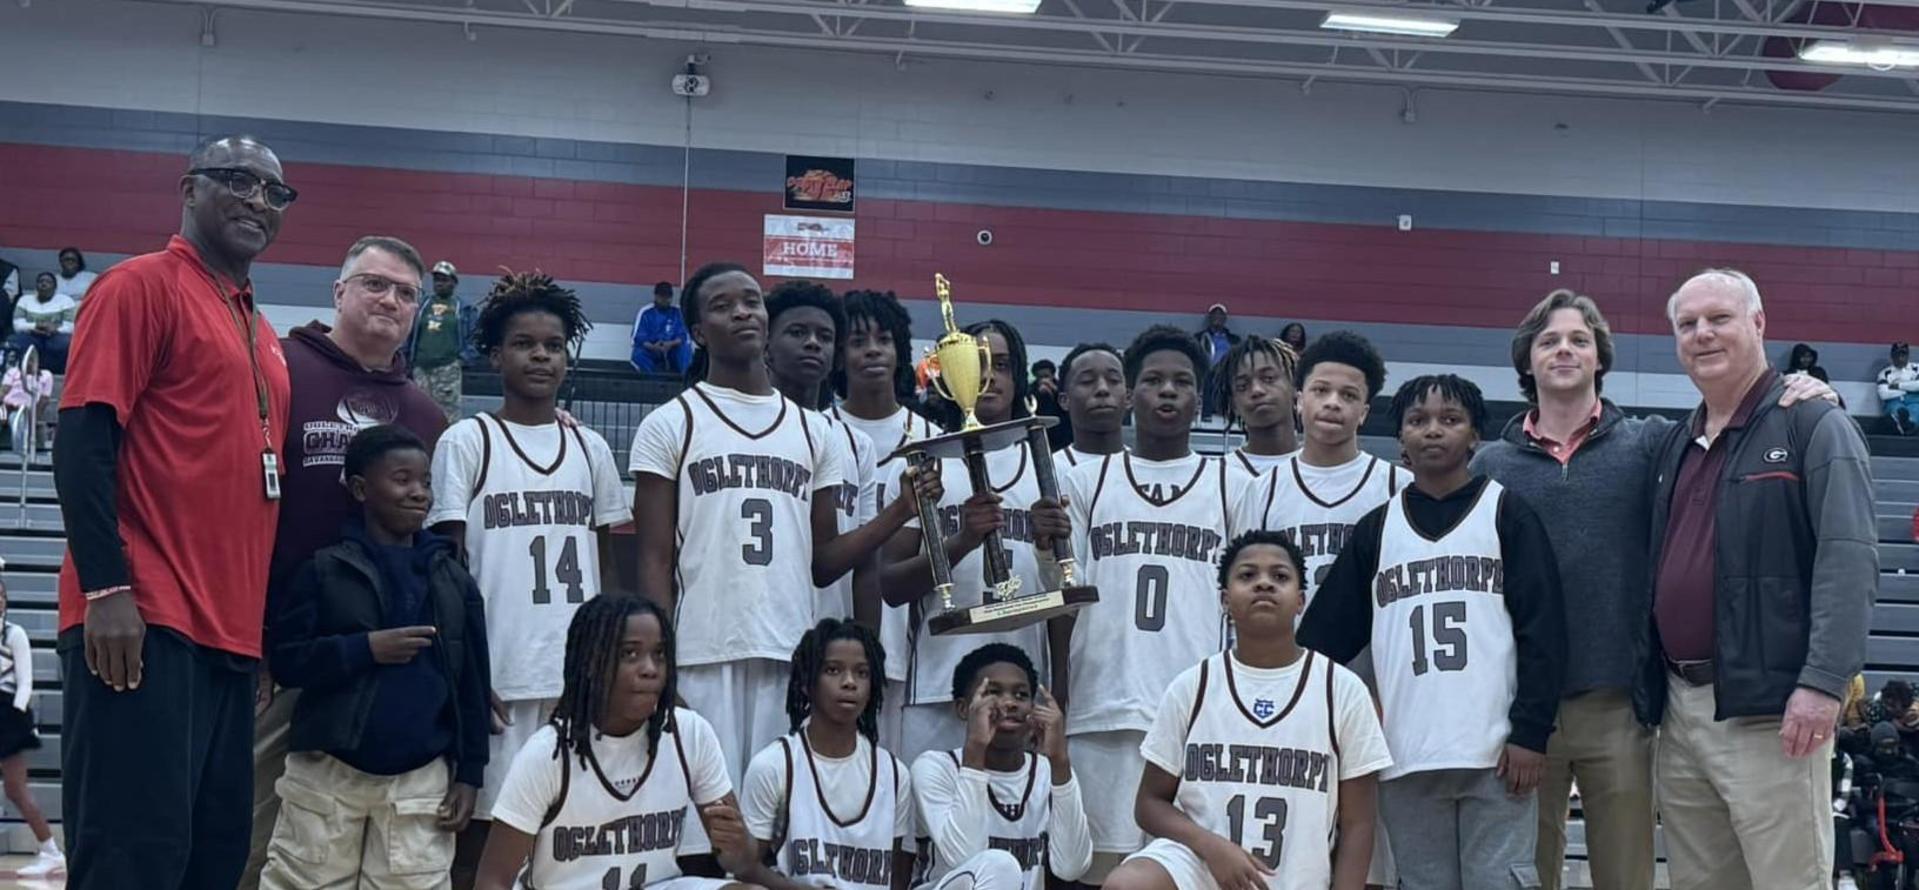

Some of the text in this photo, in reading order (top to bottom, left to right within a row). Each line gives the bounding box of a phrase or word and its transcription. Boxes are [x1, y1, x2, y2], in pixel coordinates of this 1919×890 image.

[782, 241, 838, 258] HOME
[484, 490, 597, 532] OGLETHOP
[741, 498, 774, 566] 3
[529, 535, 584, 604] 14
[1135, 564, 1169, 632] 0
[1409, 601, 1467, 676] 15
[553, 805, 687, 862] OGLETHORP
[1226, 794, 1288, 870] 13
